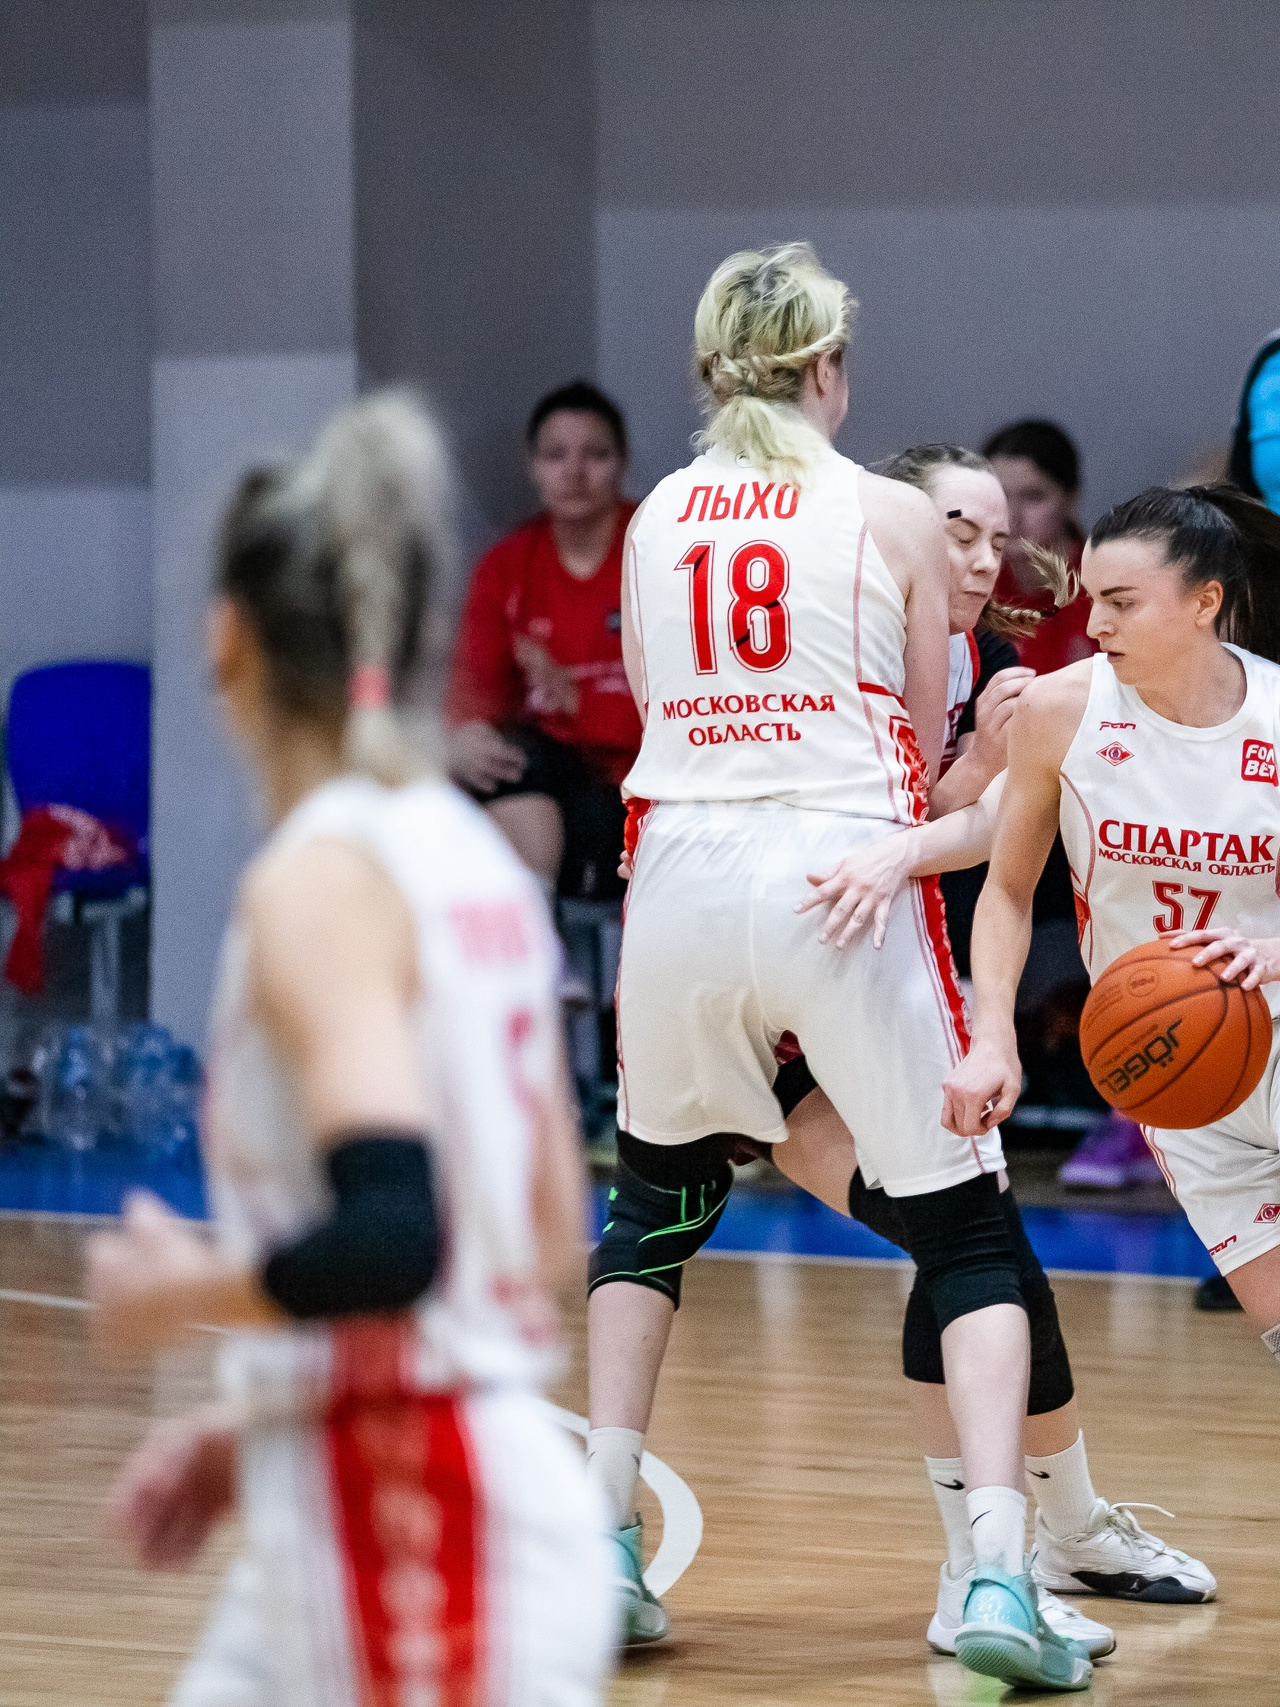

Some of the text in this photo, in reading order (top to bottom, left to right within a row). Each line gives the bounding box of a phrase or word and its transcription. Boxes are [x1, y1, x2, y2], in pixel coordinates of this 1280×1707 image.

[676, 480, 801, 523] ЛЫХО
[673, 539, 792, 676] 18
[662, 693, 836, 721] МОСКОВСКАЯ
[688, 722, 802, 747] ОБЛАСТЬ
[1098, 819, 1275, 864] СПАРТАК
[1098, 848, 1275, 877] МОСКОВСКАЯ ОБЛАСТЬ
[1152, 880, 1222, 934] 57
